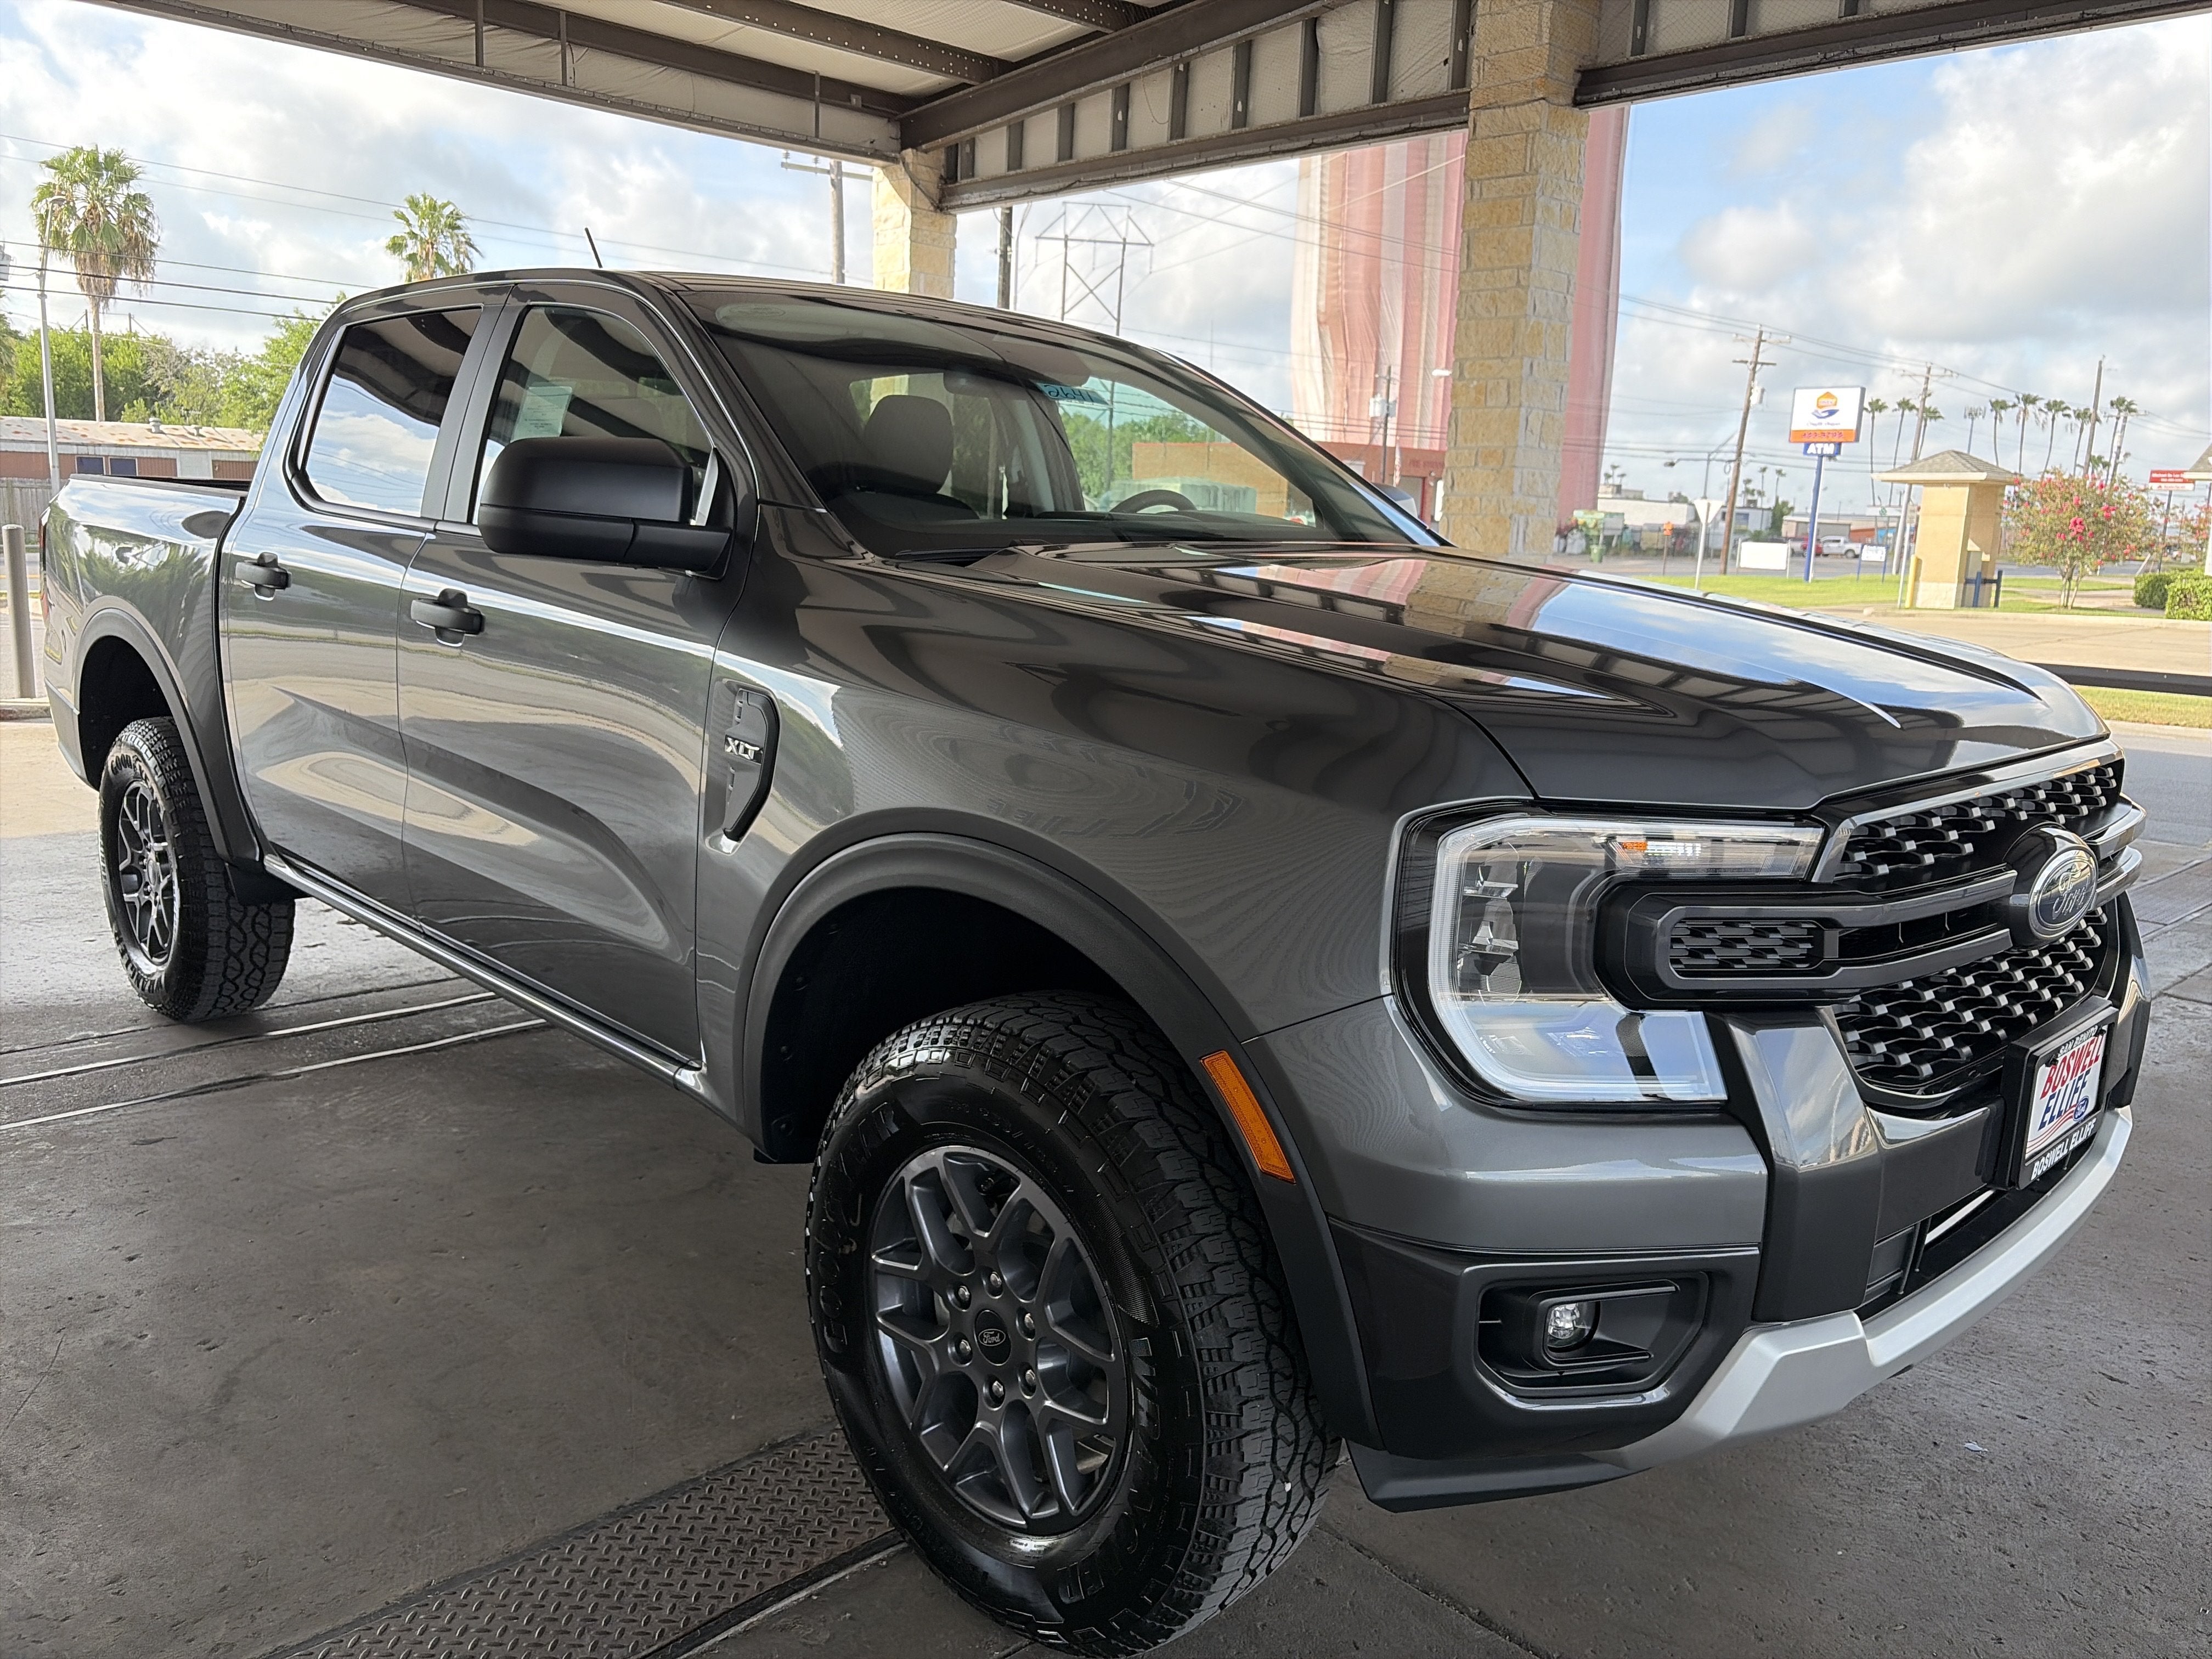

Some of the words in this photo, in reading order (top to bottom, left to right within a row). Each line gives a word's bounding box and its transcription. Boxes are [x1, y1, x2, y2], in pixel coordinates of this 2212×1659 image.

[1807, 443, 1835, 454] ATM
[726, 737, 760, 760] XLT
[2058, 1040, 2074, 1057] SAN
[2073, 1025, 2098, 1048] BENITO
[2040, 1034, 2104, 1099] BOSWELL
[2038, 1068, 2091, 1131] ELLIFF
[2031, 1138, 2069, 1181] BOSWELL
[2069, 1118, 2097, 1151] ELLIFF
[983, 1331, 1000, 1344] Ford
